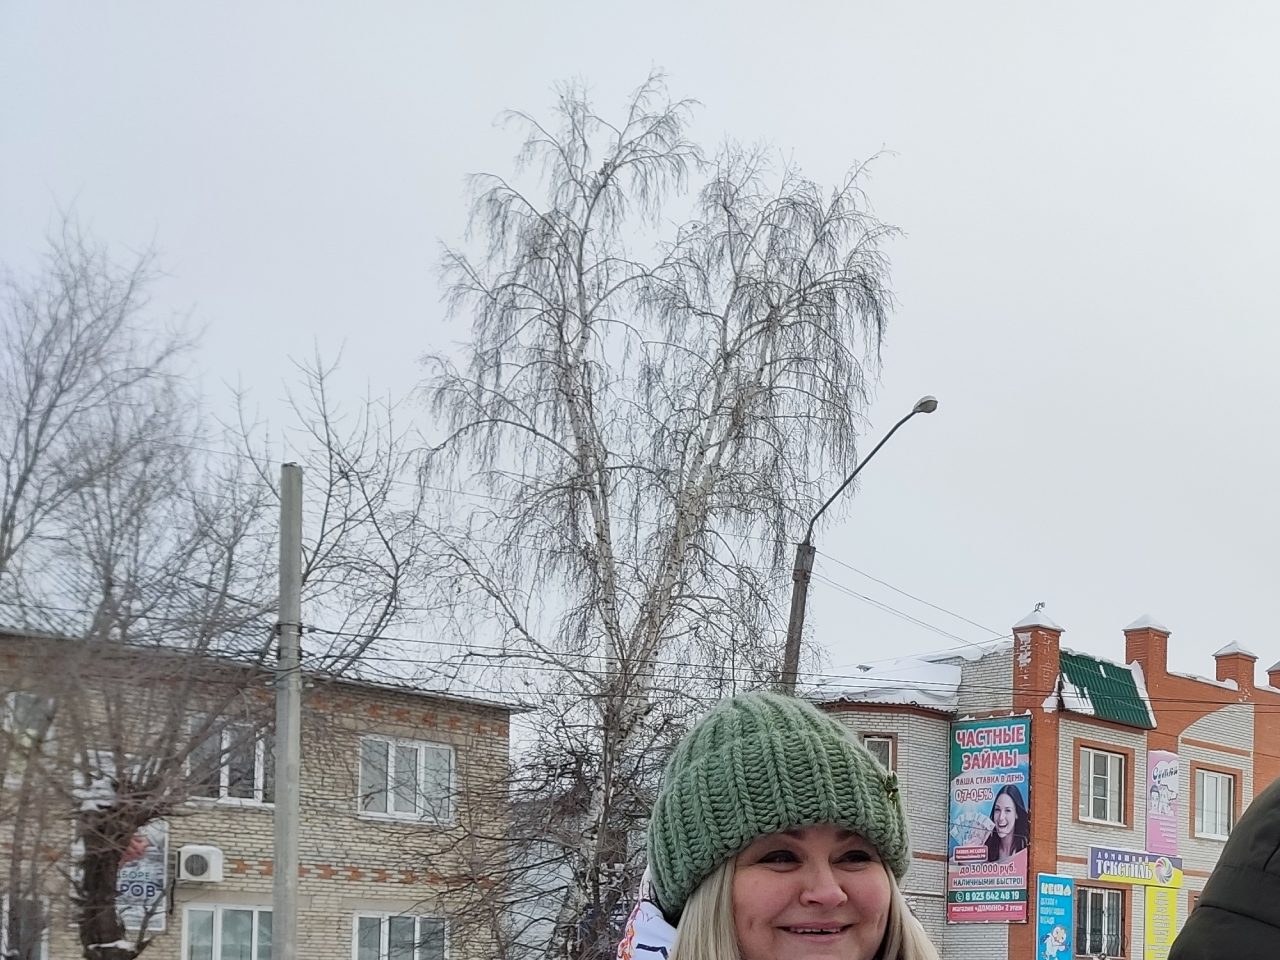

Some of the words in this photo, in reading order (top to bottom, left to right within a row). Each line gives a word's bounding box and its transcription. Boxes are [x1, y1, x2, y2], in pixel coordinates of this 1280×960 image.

[956, 725, 1025, 748] ЧАСТНЫЕ
[963, 750, 1017, 771] ЗАЙМЫ
[956, 776, 974, 785] ВАША
[976, 774, 999, 784] СТАВКА
[1006, 773, 1024, 783] ДЕНЬ
[960, 865, 969, 875] до
[971, 864, 980, 874] 30
[983, 864, 998, 873] 000
[1000, 862, 1016, 876] руб.
[1096, 860, 1153, 879] ТЕКСТИЛЬ
[119, 883, 155, 897] РОВ
[965, 893, 970, 901] 8
[972, 892, 984, 901] 923
[986, 891, 999, 900] 642
[1012, 891, 1020, 900] 19
